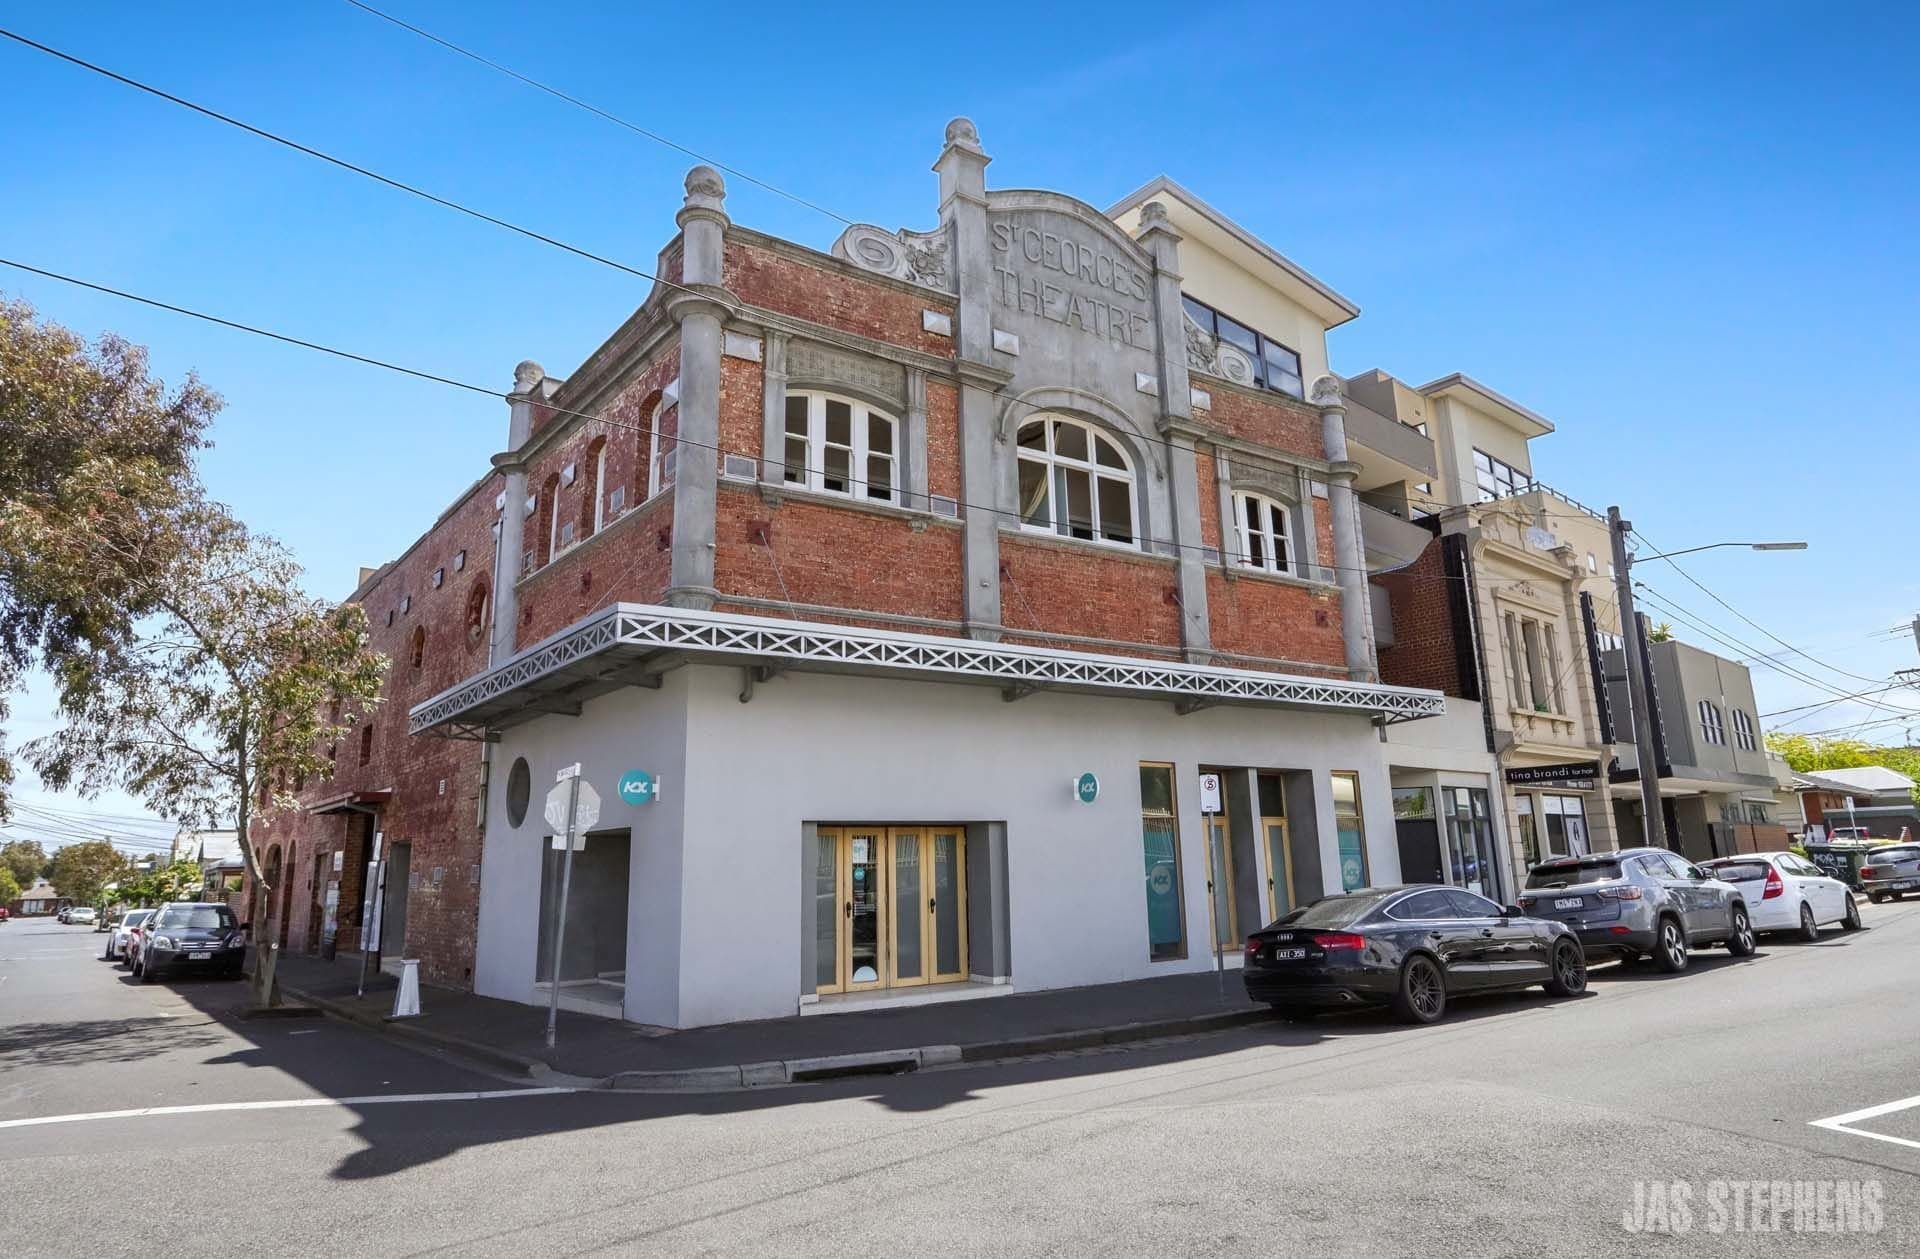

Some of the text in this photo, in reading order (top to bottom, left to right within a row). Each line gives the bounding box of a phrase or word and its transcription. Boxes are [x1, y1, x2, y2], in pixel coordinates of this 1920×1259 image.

[992, 264, 1152, 351] THEATRE
[1510, 769, 1531, 780] tina
[1533, 767, 1569, 778] brandi
